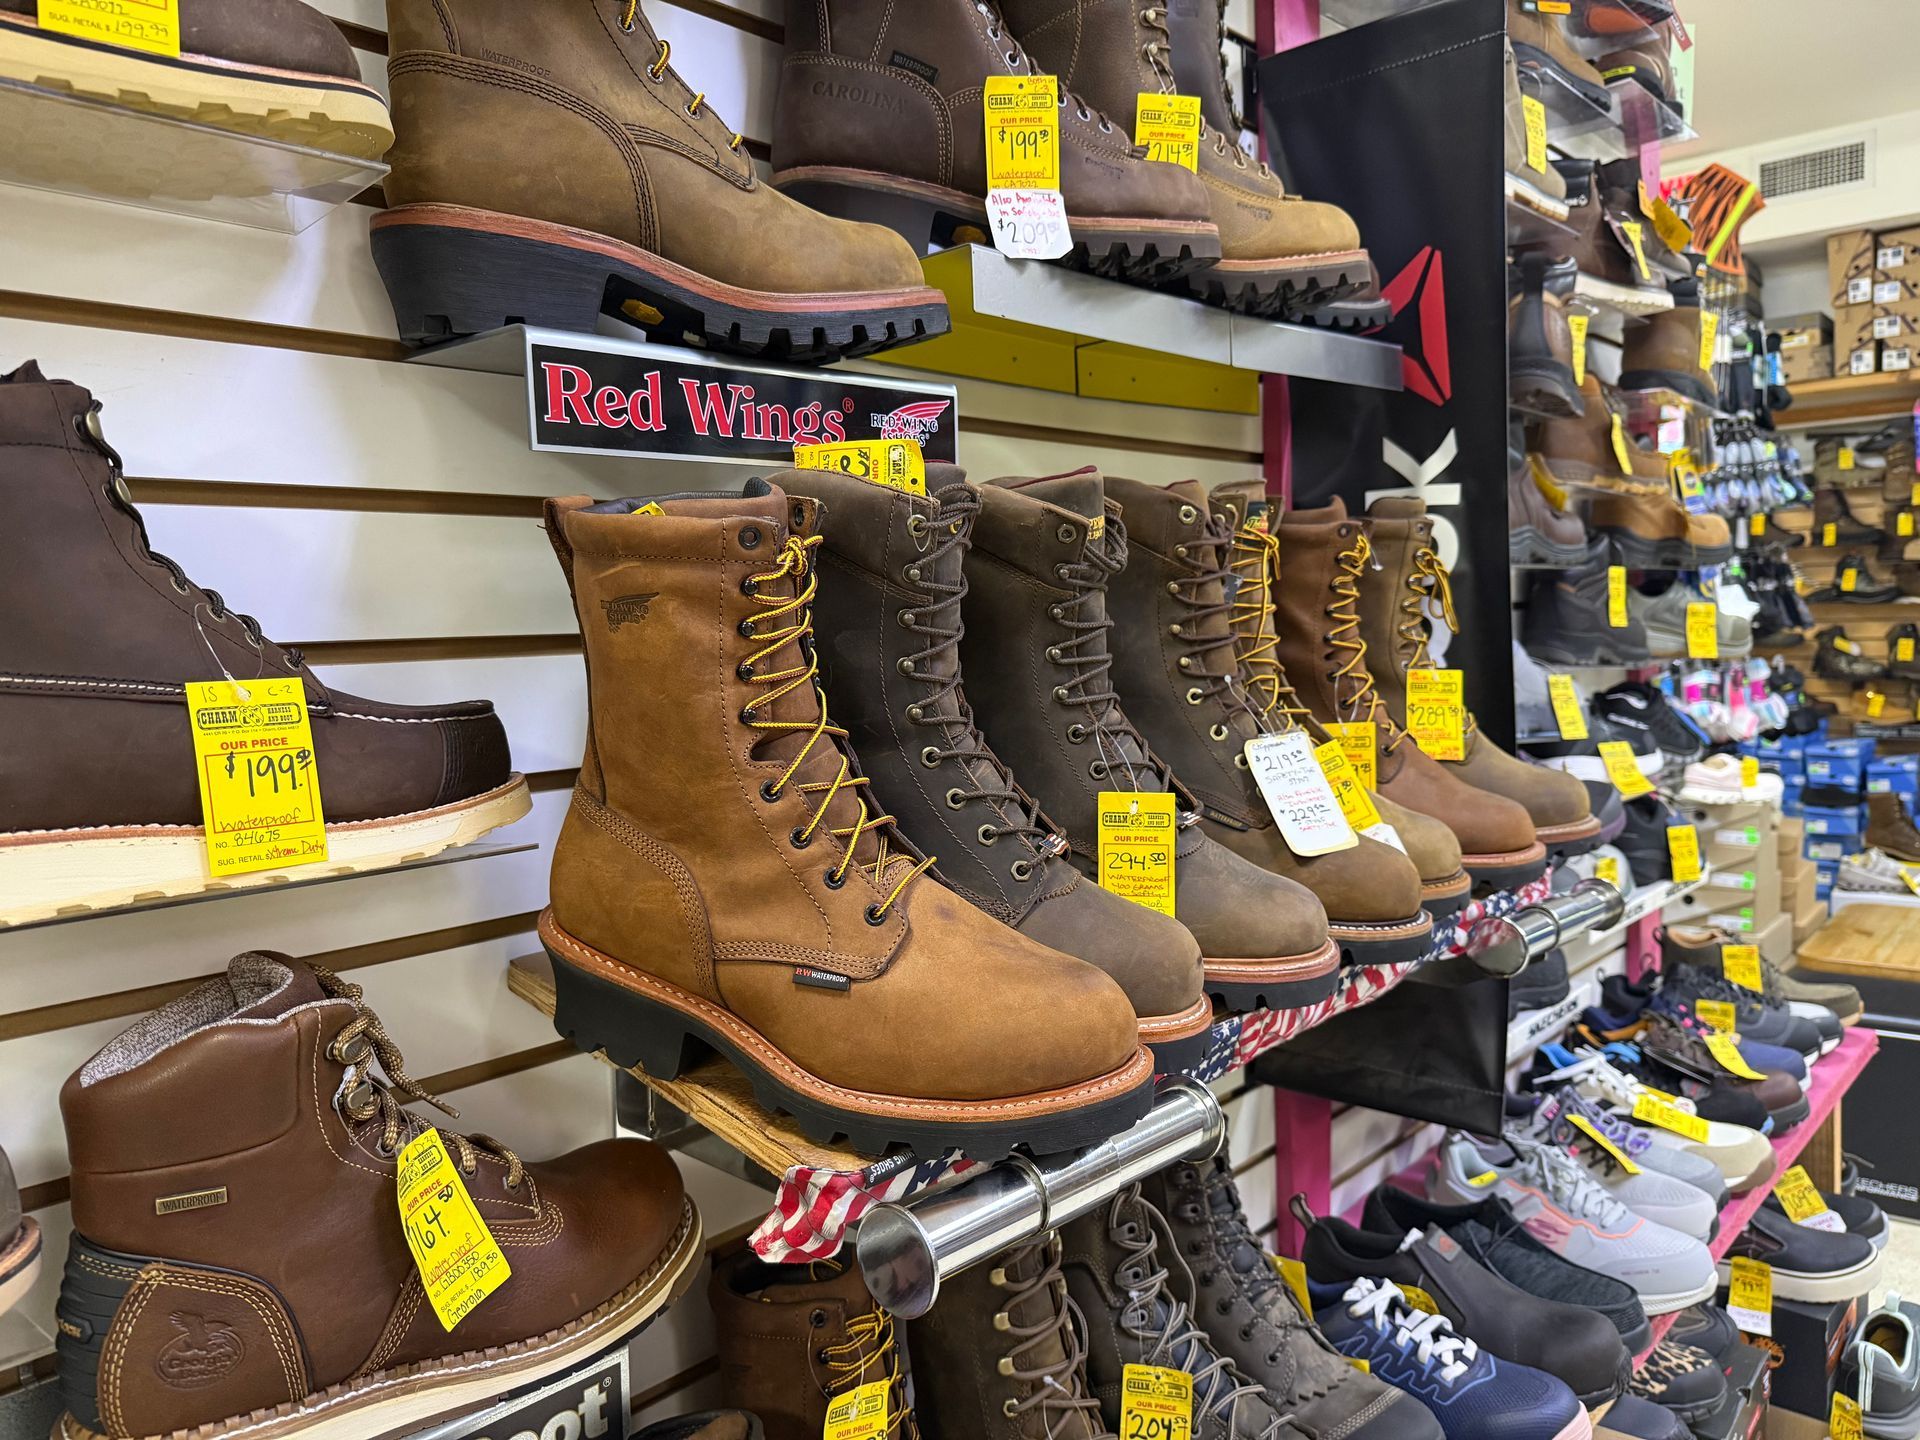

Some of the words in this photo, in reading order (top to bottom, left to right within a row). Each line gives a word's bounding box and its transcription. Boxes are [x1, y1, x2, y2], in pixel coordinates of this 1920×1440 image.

[481, 47, 552, 78] WATERPROOF
[893, 54, 934, 77] WATERPROOF
[812, 80, 905, 114] CAROLINA
[990, 96, 1014, 107] CHARM
[1000, 117, 1017, 125] OUR
[1019, 116, 1043, 124] PRICE
[541, 361, 667, 432] Red
[870, 412, 896, 428] RED
[902, 416, 939, 433] WING
[871, 459, 879, 480] OUR
[200, 710, 238, 725] CHARM
[220, 741, 248, 751] OUR
[251, 737, 289, 748] PRICE
[215, 841, 230, 850] NO.
[1113, 835, 1132, 843] OUR
[1133, 835, 1159, 843] PRICE
[217, 859, 237, 867] SUG.
[238, 854, 263, 864] RETAIL
[301, 839, 325, 857] Duty
[811, 970, 848, 983] WATERPROOF
[161, 1191, 223, 1213] WATERPROOF
[406, 1197, 420, 1212] OUR
[419, 1179, 443, 1200] PRICE
[447, 1288, 487, 1325] Georgia
[1136, 1400, 1153, 1409] OUR
[1154, 1402, 1178, 1412] PRICE
[836, 1428, 851, 1439] OUR
[852, 1422, 874, 1434] PRICE
